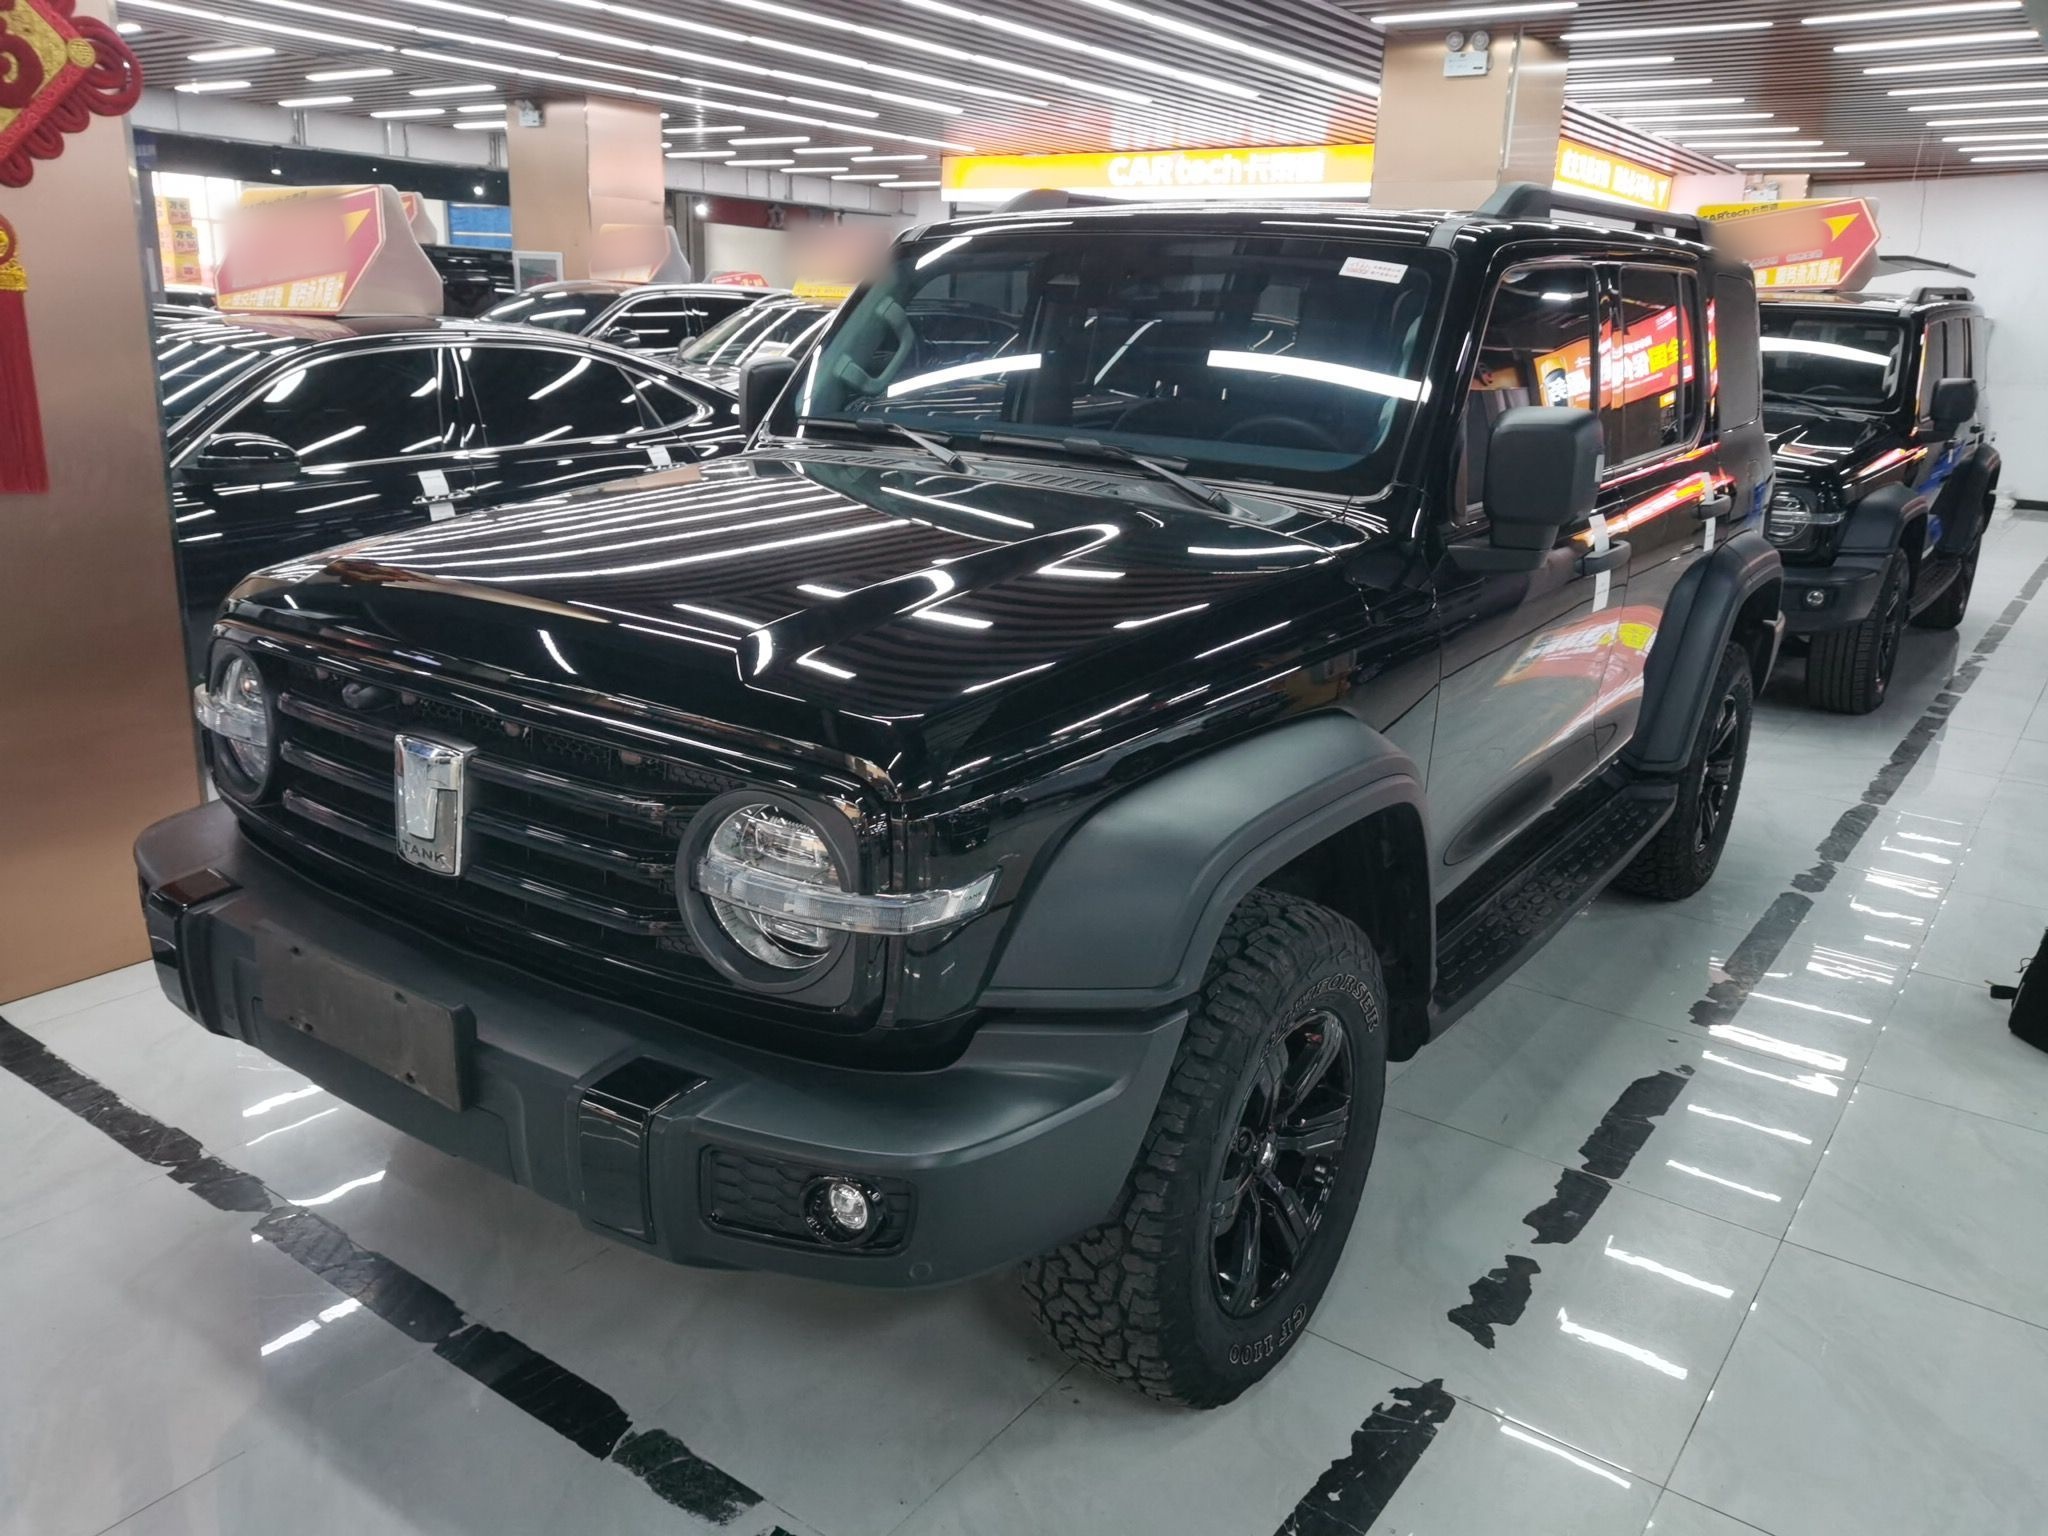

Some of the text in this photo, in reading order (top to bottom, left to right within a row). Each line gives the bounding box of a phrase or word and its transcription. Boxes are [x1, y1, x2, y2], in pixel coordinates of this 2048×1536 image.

[402, 841, 445, 864] TANK
[1229, 1302, 1307, 1366] CF 1100
